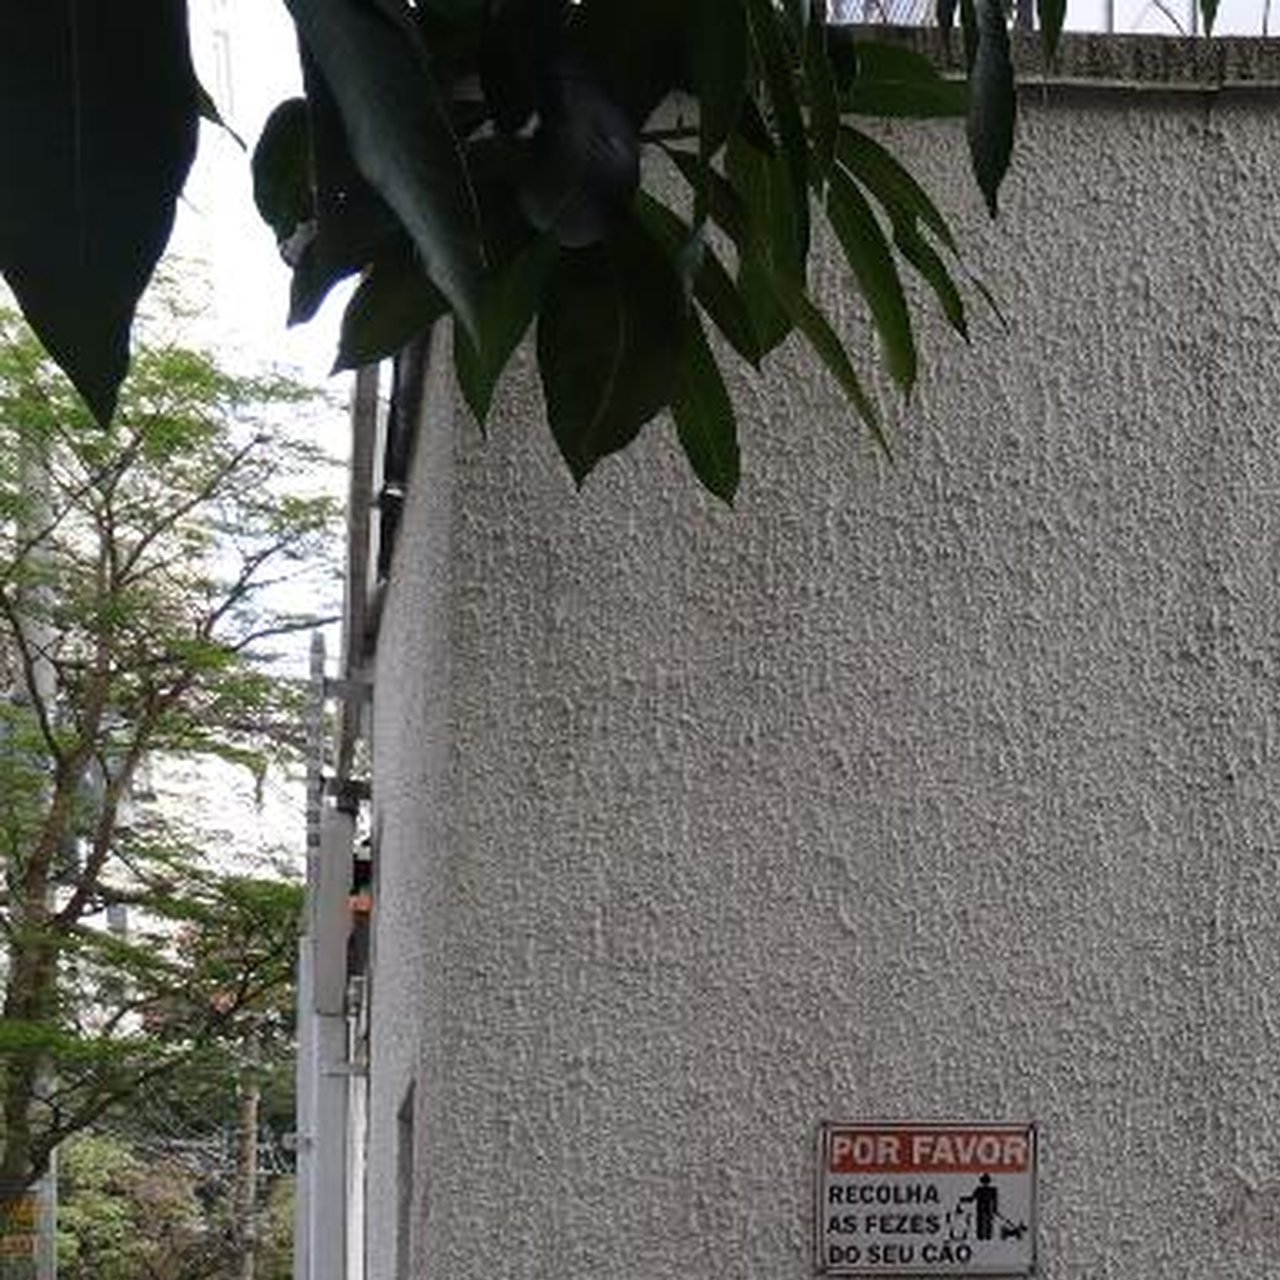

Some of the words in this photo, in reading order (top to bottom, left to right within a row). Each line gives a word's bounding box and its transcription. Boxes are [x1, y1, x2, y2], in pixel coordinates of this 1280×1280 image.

[831, 1135, 900, 1165] POR
[911, 1134, 1028, 1165] FAVOR
[828, 1184, 941, 1205] RECOLHA
[827, 1214, 858, 1235] AS
[865, 1214, 942, 1235] FEZES
[829, 1244, 861, 1264] DO
[868, 1244, 914, 1264] SEU
[922, 1239, 973, 1264] CÃO
